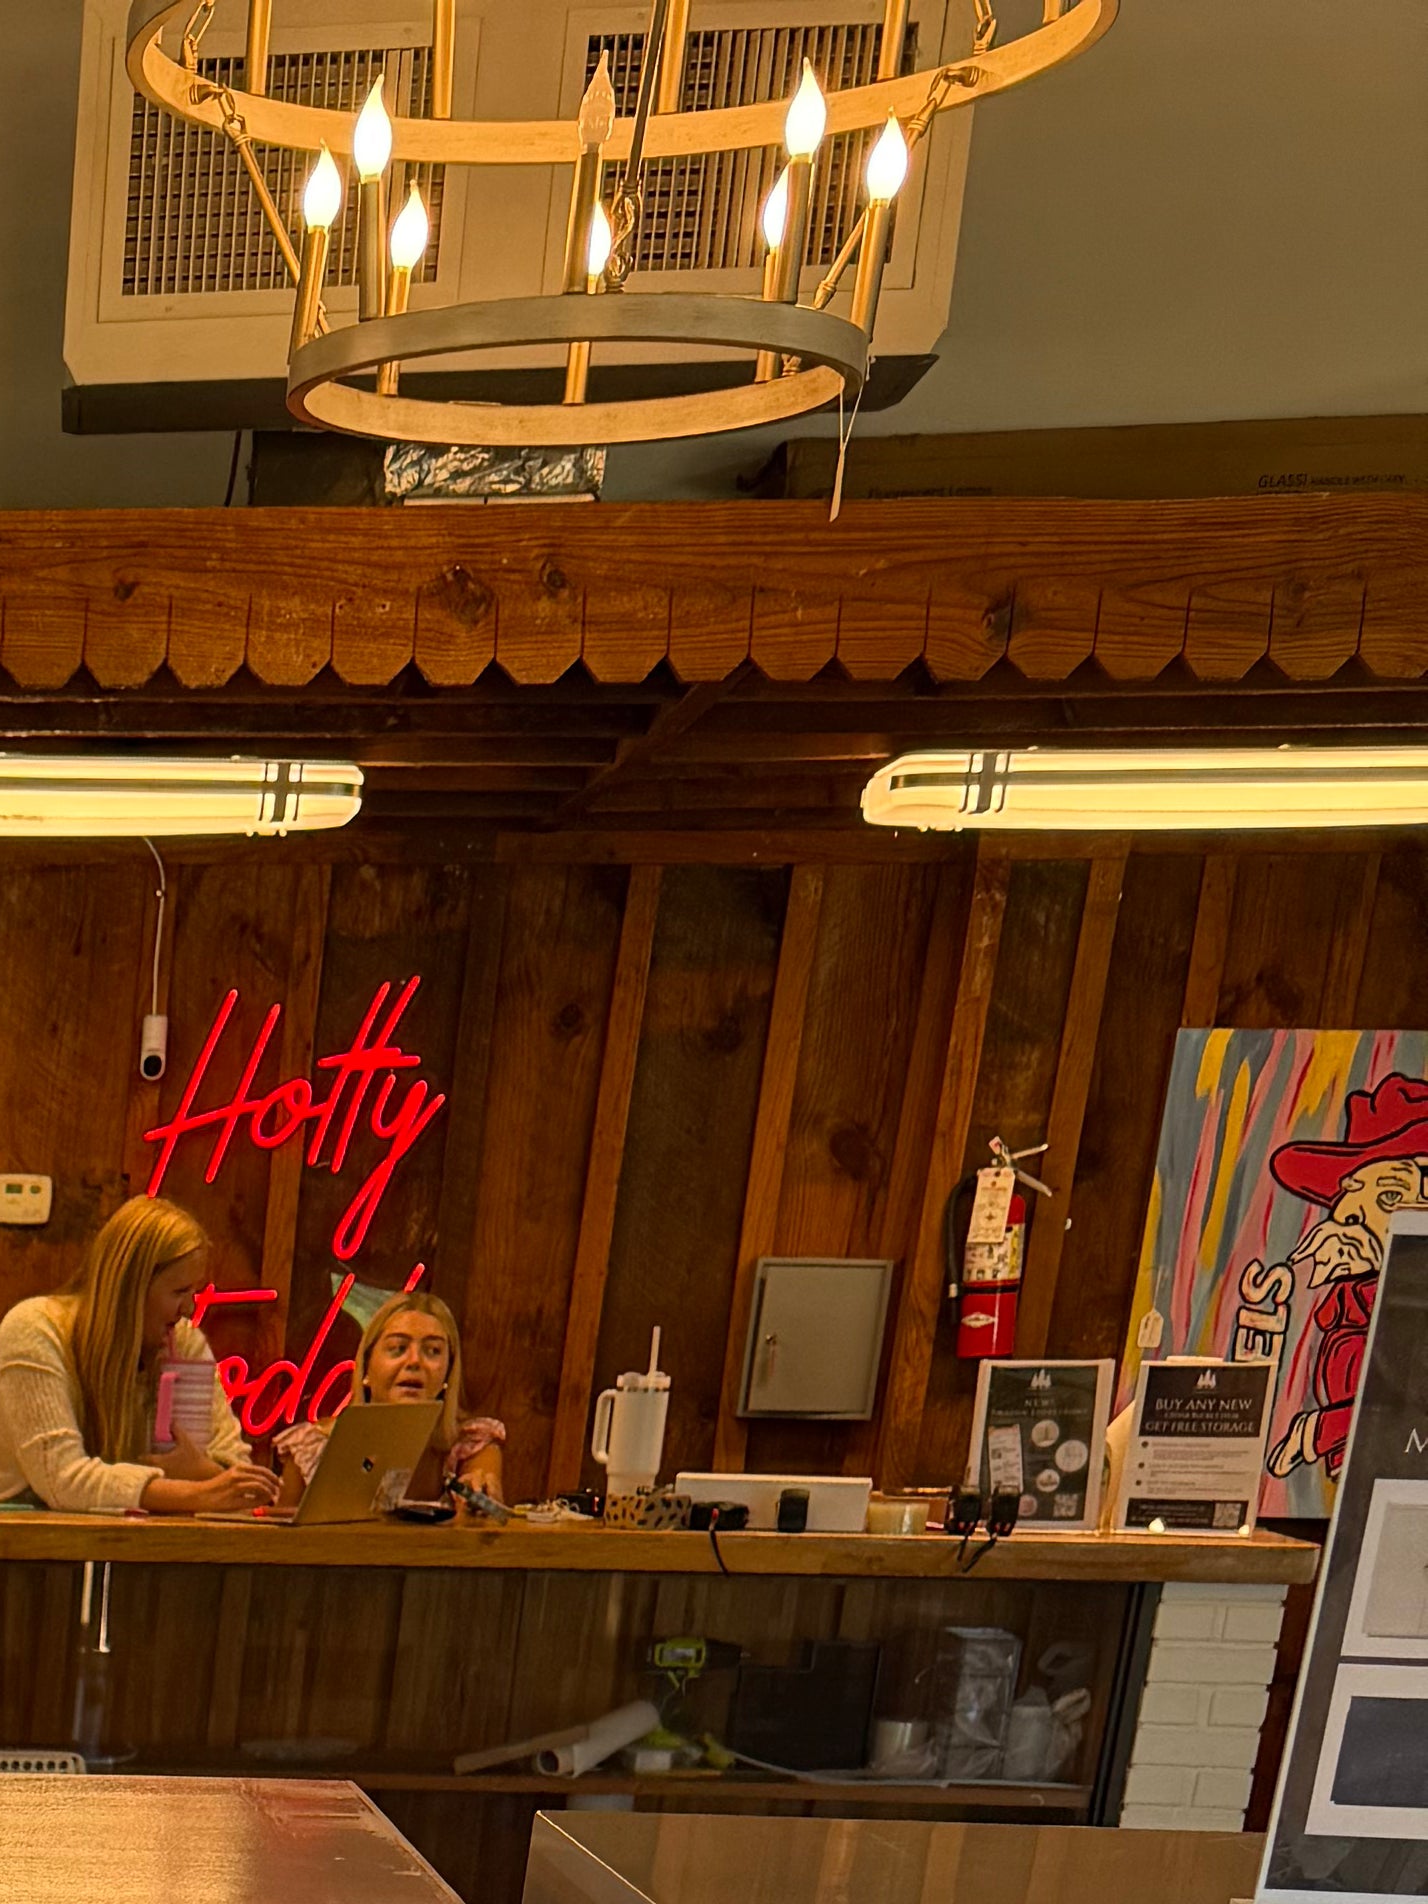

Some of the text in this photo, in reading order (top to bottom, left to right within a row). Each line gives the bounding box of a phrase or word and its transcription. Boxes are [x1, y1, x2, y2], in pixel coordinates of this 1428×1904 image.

[144, 974, 446, 1261] Hotty
[1155, 1398, 1253, 1411] BUY ANY NEW
